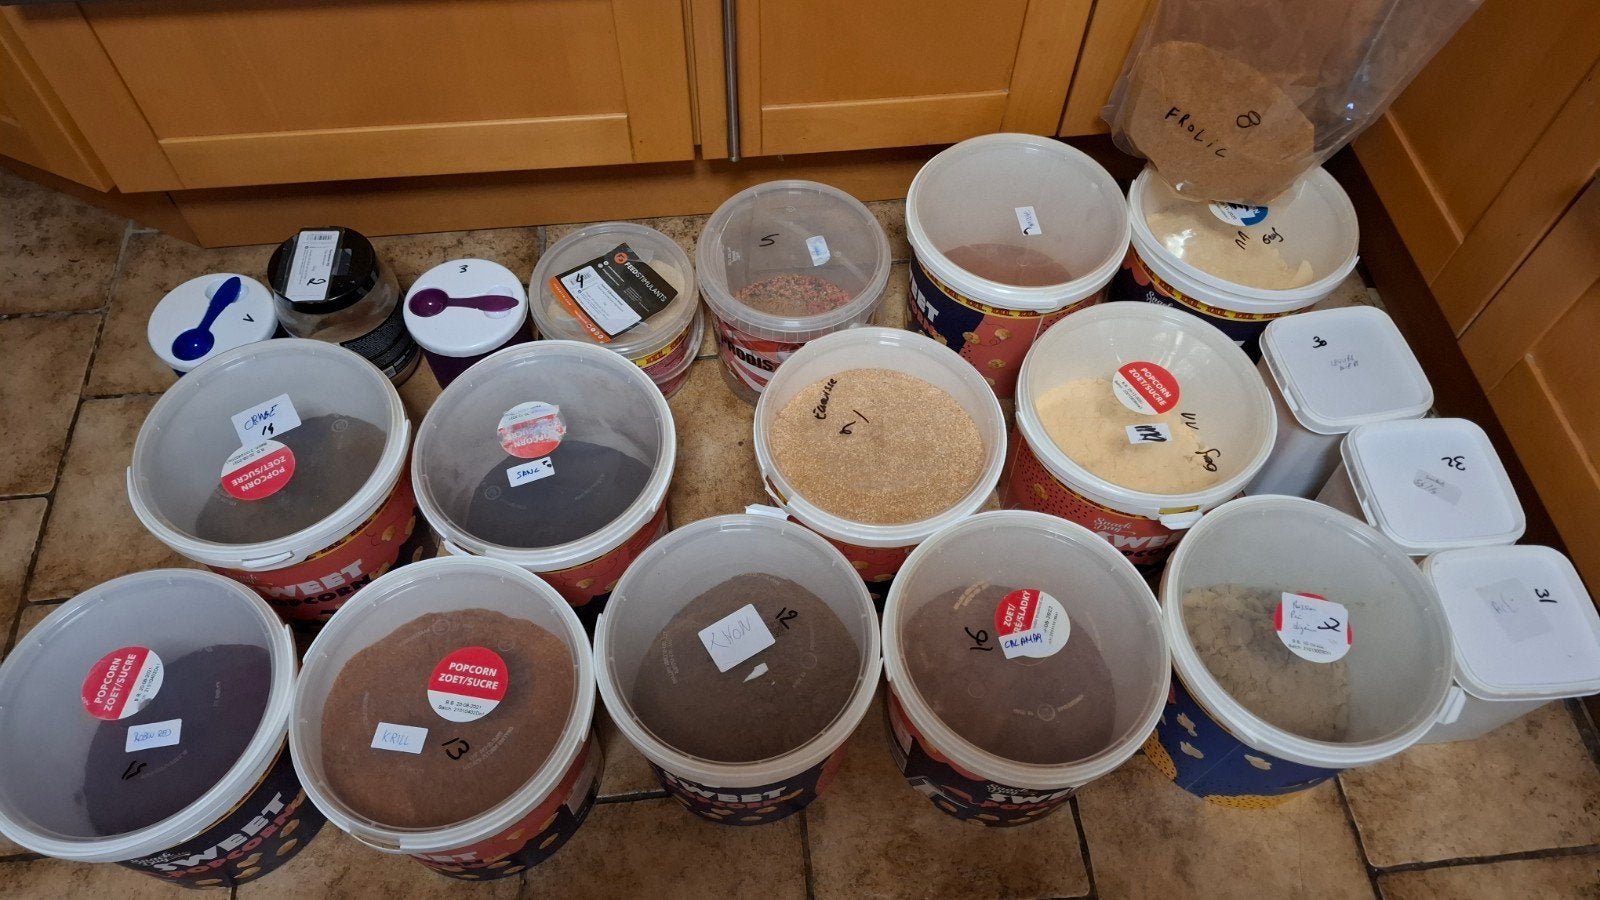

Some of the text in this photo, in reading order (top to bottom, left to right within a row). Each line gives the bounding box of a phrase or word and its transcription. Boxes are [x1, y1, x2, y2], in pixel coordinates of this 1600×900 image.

[1236, 110, 1261, 129] 8
[759, 233, 780, 247] 5
[459, 264, 469, 273] 3
[576, 273, 585, 289] 4
[1312, 336, 1328, 348] 30
[1128, 367, 1167, 407] ZOET/SUCRE
[1140, 366, 1172, 398] POPCORN
[231, 455, 287, 488] ZOET/SUCRE
[1441, 456, 1466, 471] 32
[240, 466, 286, 493] POPCORN
[1534, 588, 1558, 604] 31
[774, 606, 799, 630] 12
[1003, 603, 1016, 628] ZOET/
[448, 661, 498, 677] POPCORN
[93, 656, 122, 705] POPCORN
[103, 652, 137, 712] ZOET/SUCRE
[437, 672, 499, 690] ZOET/SUCRE
[382, 731, 410, 746] KRILL
[153, 791, 285, 872] SWEET
